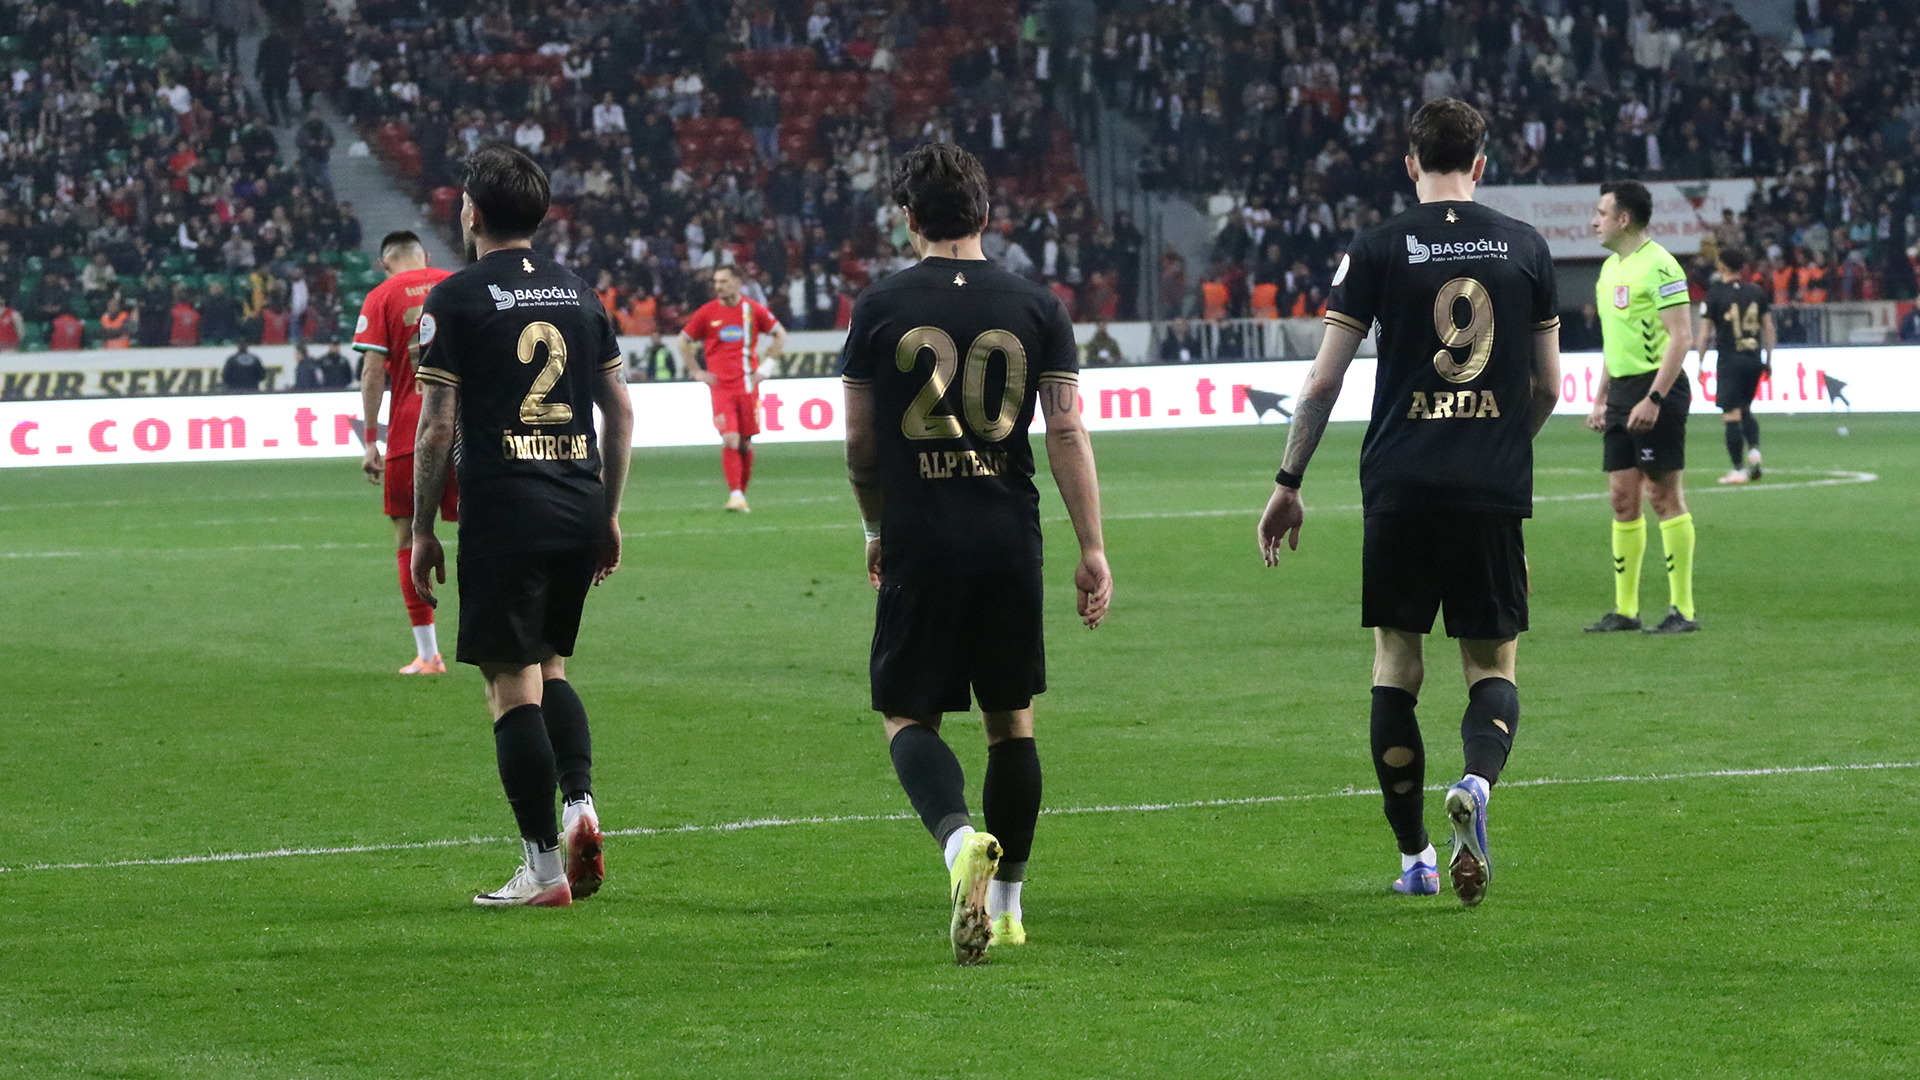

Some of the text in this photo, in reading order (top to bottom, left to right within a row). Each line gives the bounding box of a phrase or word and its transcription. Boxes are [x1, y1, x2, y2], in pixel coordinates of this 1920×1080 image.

[1431, 238, 1508, 255] BAŞOĞLU
[514, 286, 577, 301] BAŞOĞLU
[1433, 277, 1495, 384] 9
[1722, 302, 1760, 337] 14
[97, 367, 284, 398] SEYAHT
[517, 320, 573, 425] 2
[895, 325, 1028, 442] 20
[761, 378, 1252, 432] to m.tr
[1045, 382, 1074, 416] 10
[1407, 390, 1500, 420] ARDA
[502, 429, 588, 461] ÖMÜRCAN
